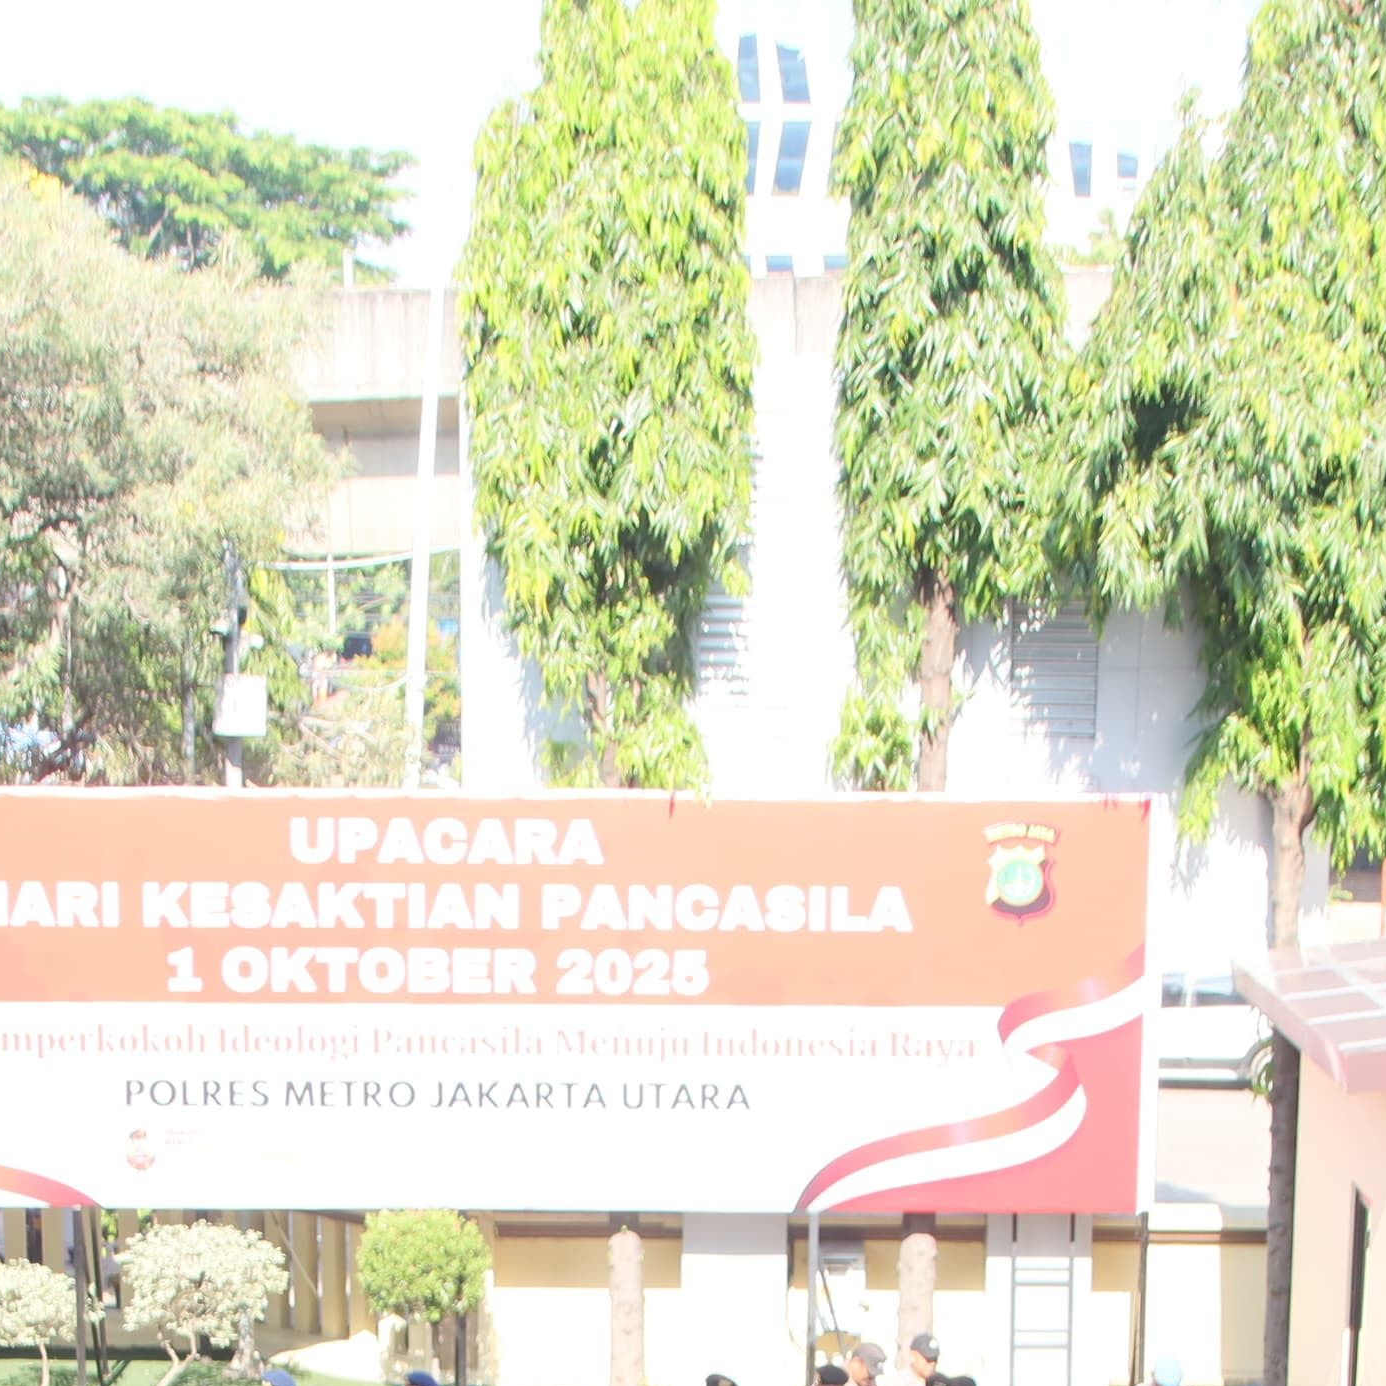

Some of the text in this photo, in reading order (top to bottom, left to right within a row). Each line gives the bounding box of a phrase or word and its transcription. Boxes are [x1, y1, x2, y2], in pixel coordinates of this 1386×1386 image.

[290, 817, 604, 864] UPACARA
[142, 882, 519, 930] KESAKTIAN
[541, 884, 913, 932] PANCASILA
[168, 947, 709, 995] 1 OKTOBER 2025
[219, 1024, 359, 1061] Ideologi
[373, 1026, 542, 1055] Pancasila
[557, 1028, 688, 1063] Menuju
[703, 1028, 876, 1057] Indonesia
[891, 1032, 975, 1065] Raya
[125, 1079, 750, 1110] POLRES METRO JAKARTA UTARA
